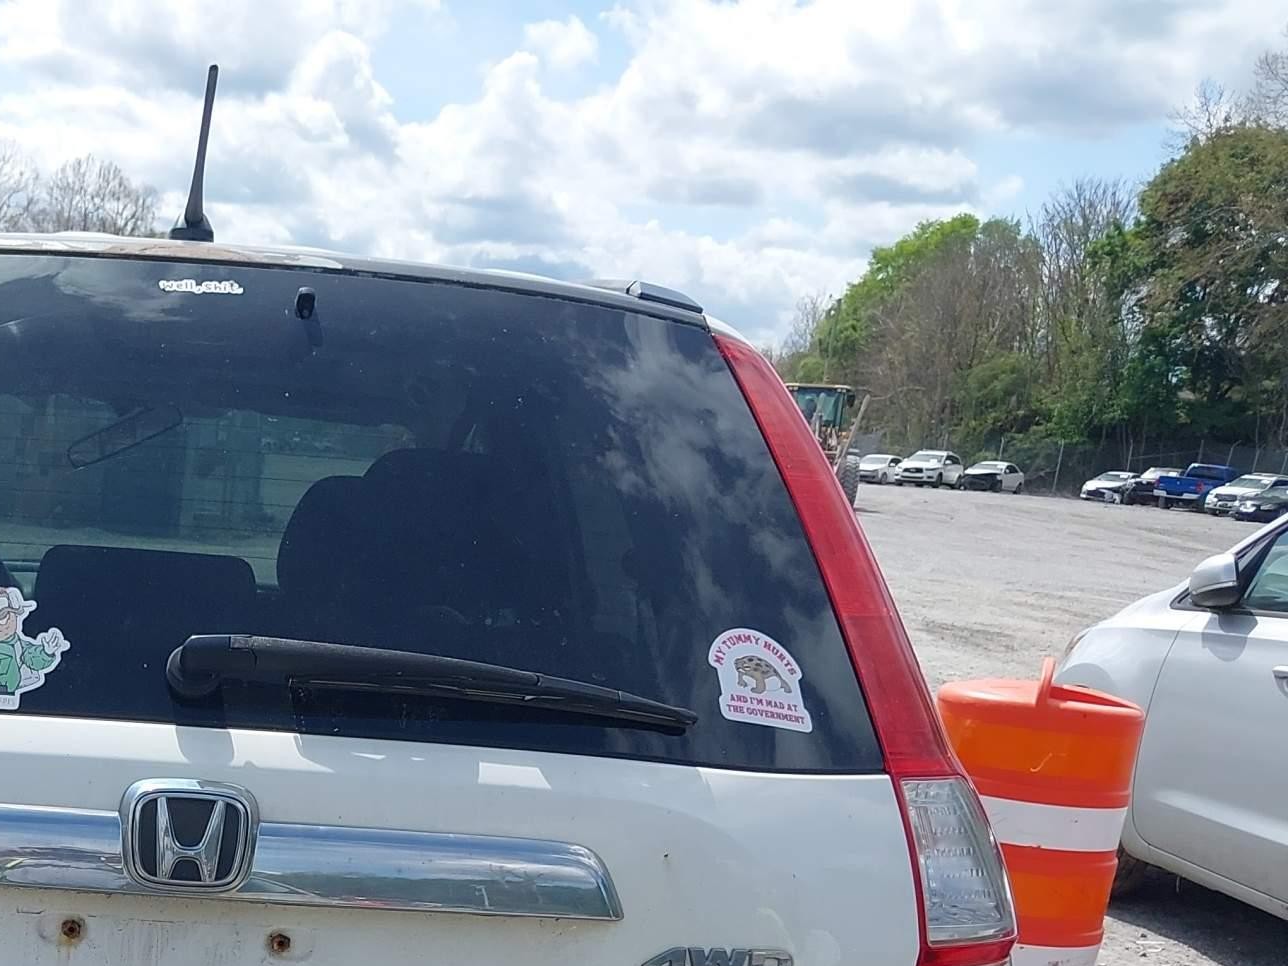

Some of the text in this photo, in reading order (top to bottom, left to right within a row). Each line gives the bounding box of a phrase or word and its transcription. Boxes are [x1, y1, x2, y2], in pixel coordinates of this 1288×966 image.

[714, 647, 726, 667] MY
[763, 641, 798, 676] HURTS
[726, 703, 805, 725] THE GOVERNMENT
[730, 694, 748, 704] AND
[765, 699, 785, 710] MAD
[786, 703, 798, 712] AT
